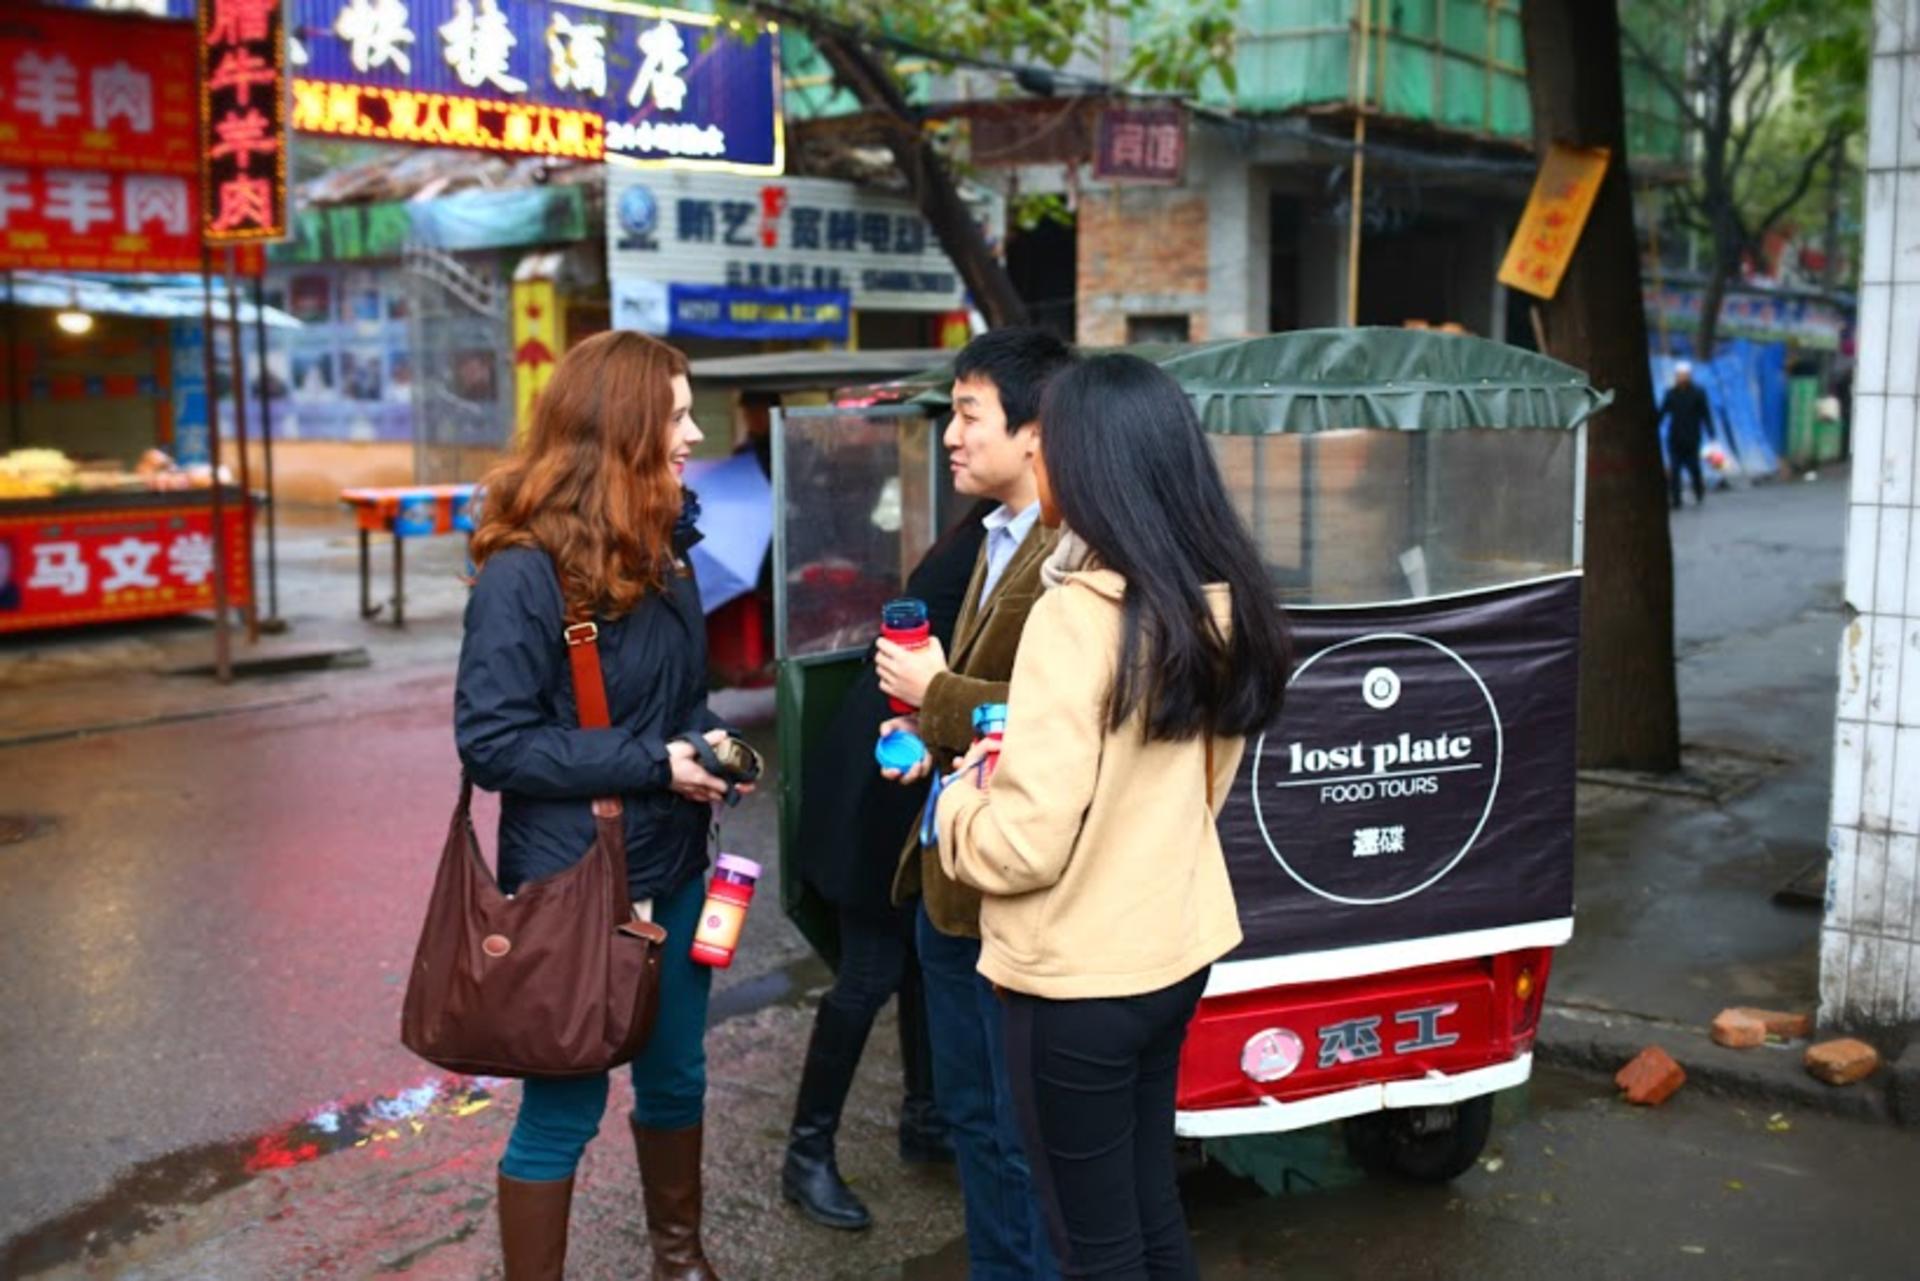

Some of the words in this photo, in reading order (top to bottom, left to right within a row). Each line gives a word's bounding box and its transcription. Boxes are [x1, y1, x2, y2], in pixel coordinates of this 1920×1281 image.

[289, 0, 690, 111] 快捷酒店
[26, 533, 214, 595] 马文学
[1289, 740, 1364, 774] lost
[1373, 732, 1472, 774] plate
[1320, 785, 1374, 803] FOOD
[1376, 776, 1438, 798] TOURS
